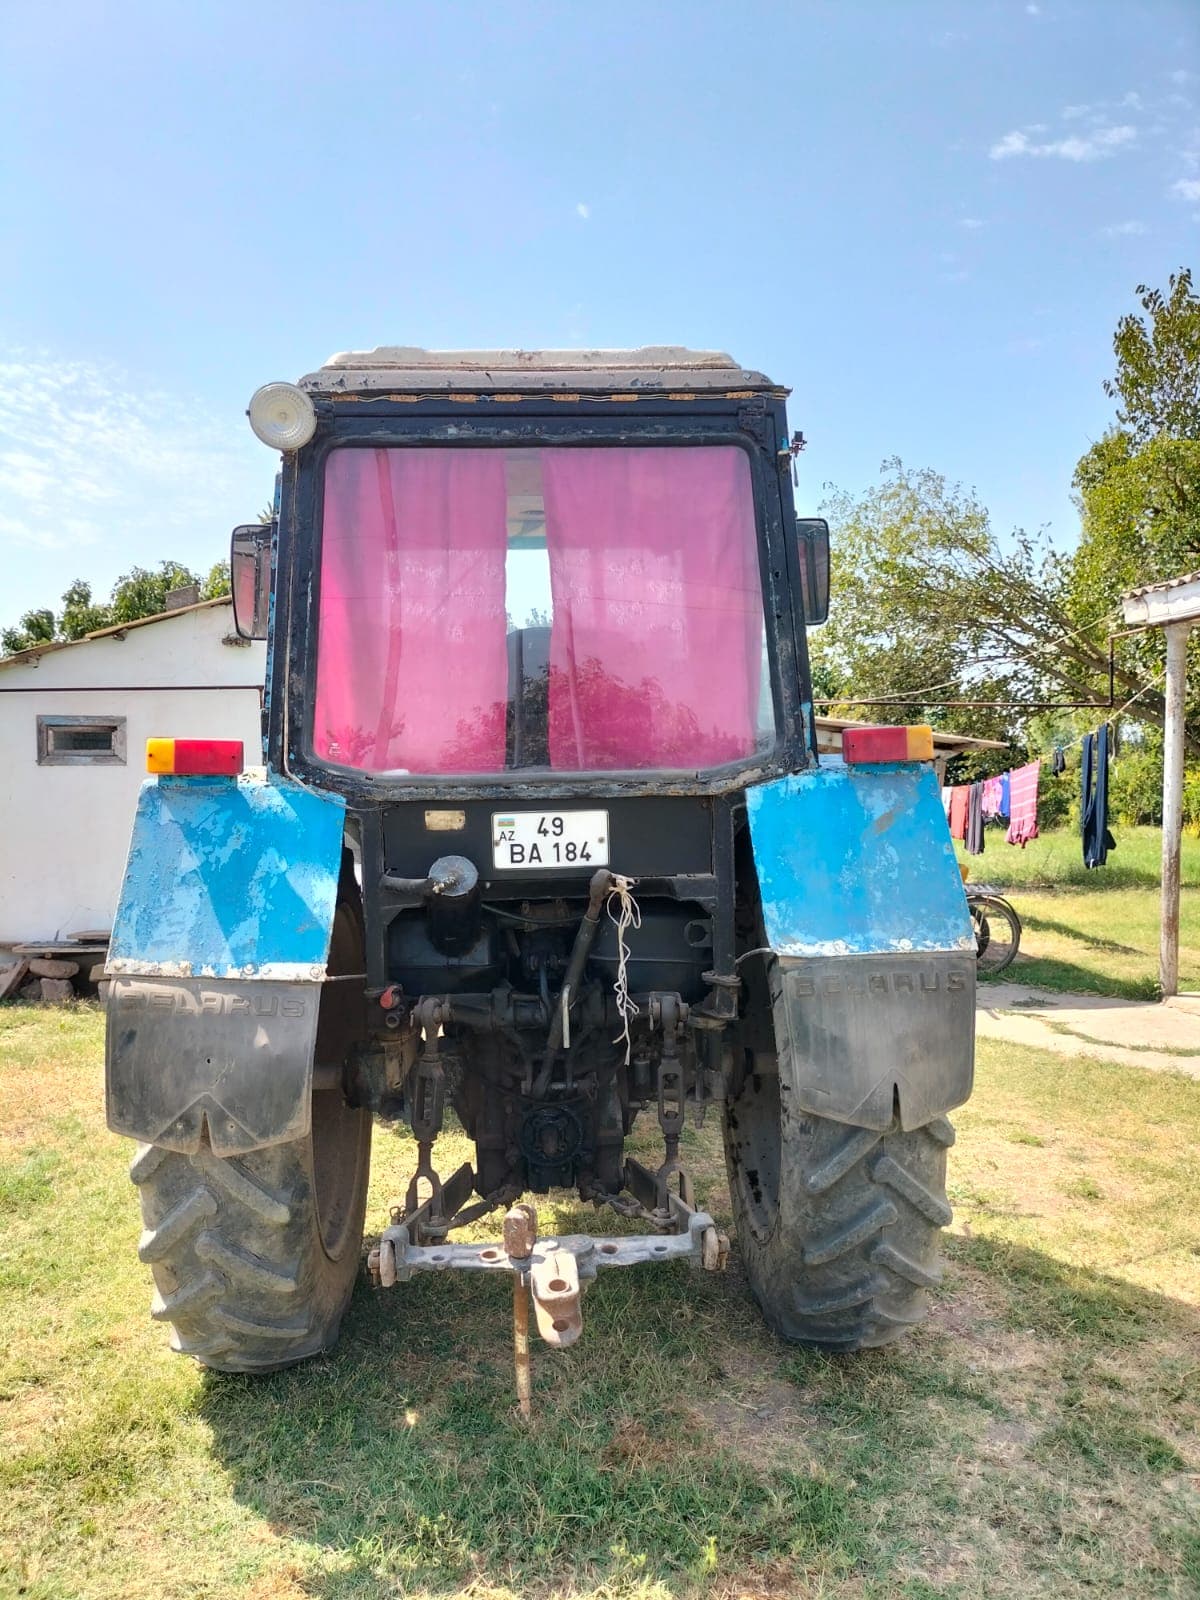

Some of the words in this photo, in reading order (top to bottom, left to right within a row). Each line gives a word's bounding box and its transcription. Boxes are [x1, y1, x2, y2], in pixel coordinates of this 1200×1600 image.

[499, 830, 515, 841] AZ
[537, 817, 564, 837] 49
[510, 843, 542, 864] BA
[553, 841, 592, 862] 184
